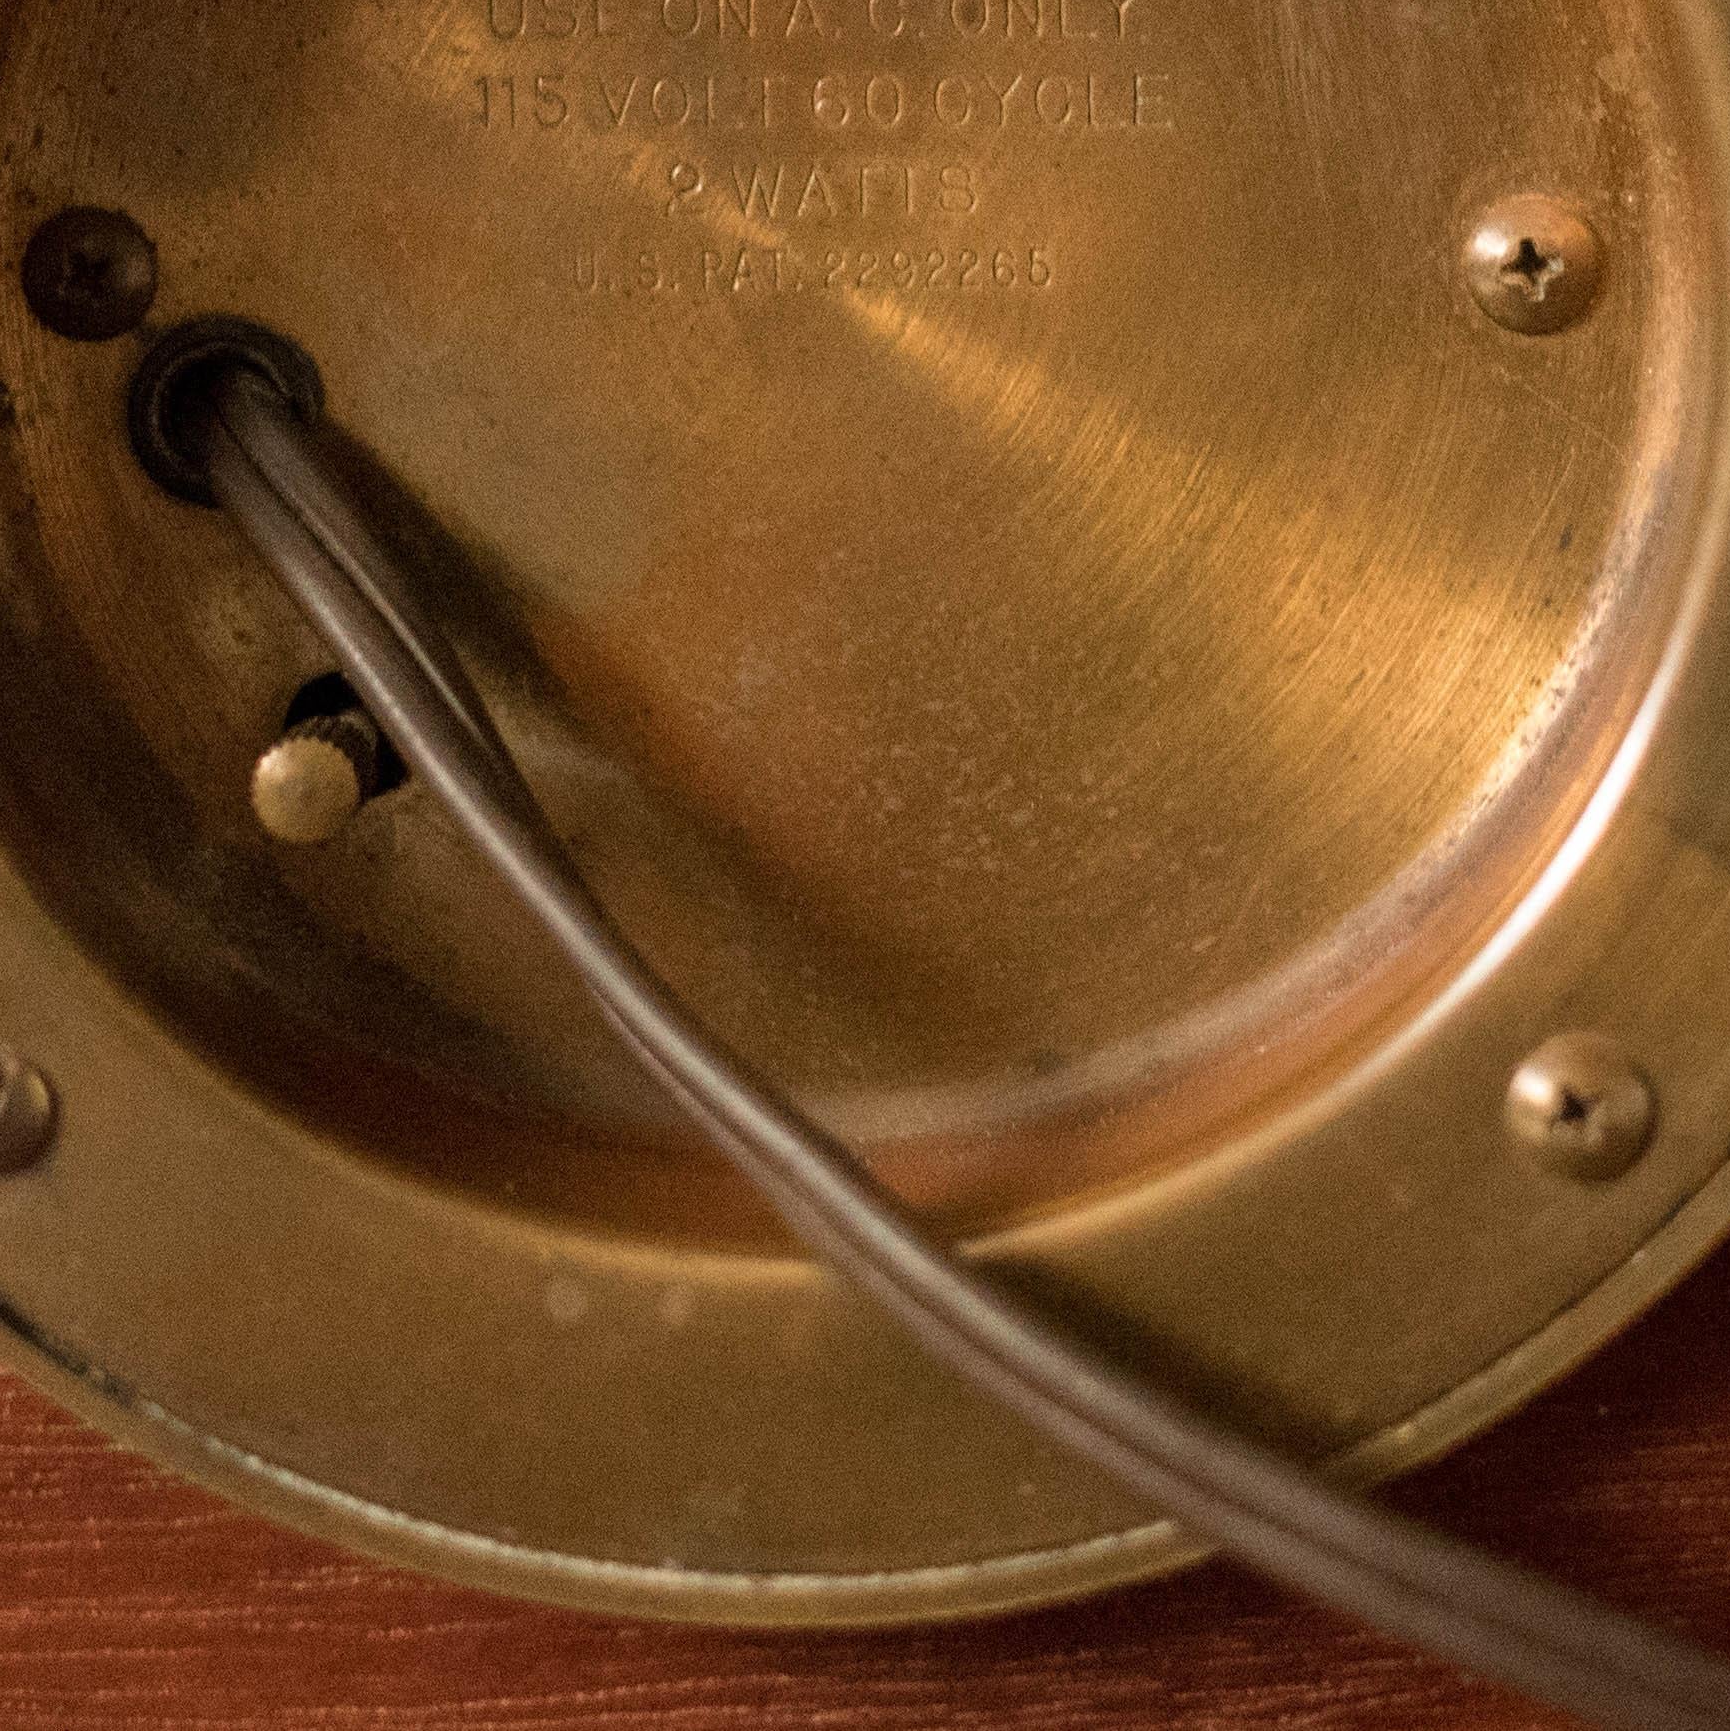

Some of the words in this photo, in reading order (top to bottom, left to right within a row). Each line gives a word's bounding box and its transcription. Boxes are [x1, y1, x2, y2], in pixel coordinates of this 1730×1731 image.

[475, 73, 570, 130] 115
[596, 74, 789, 130] VOLT
[812, 70, 907, 131] 60
[933, 70, 1175, 132] CYCLE
[730, 160, 981, 219] WATTS
